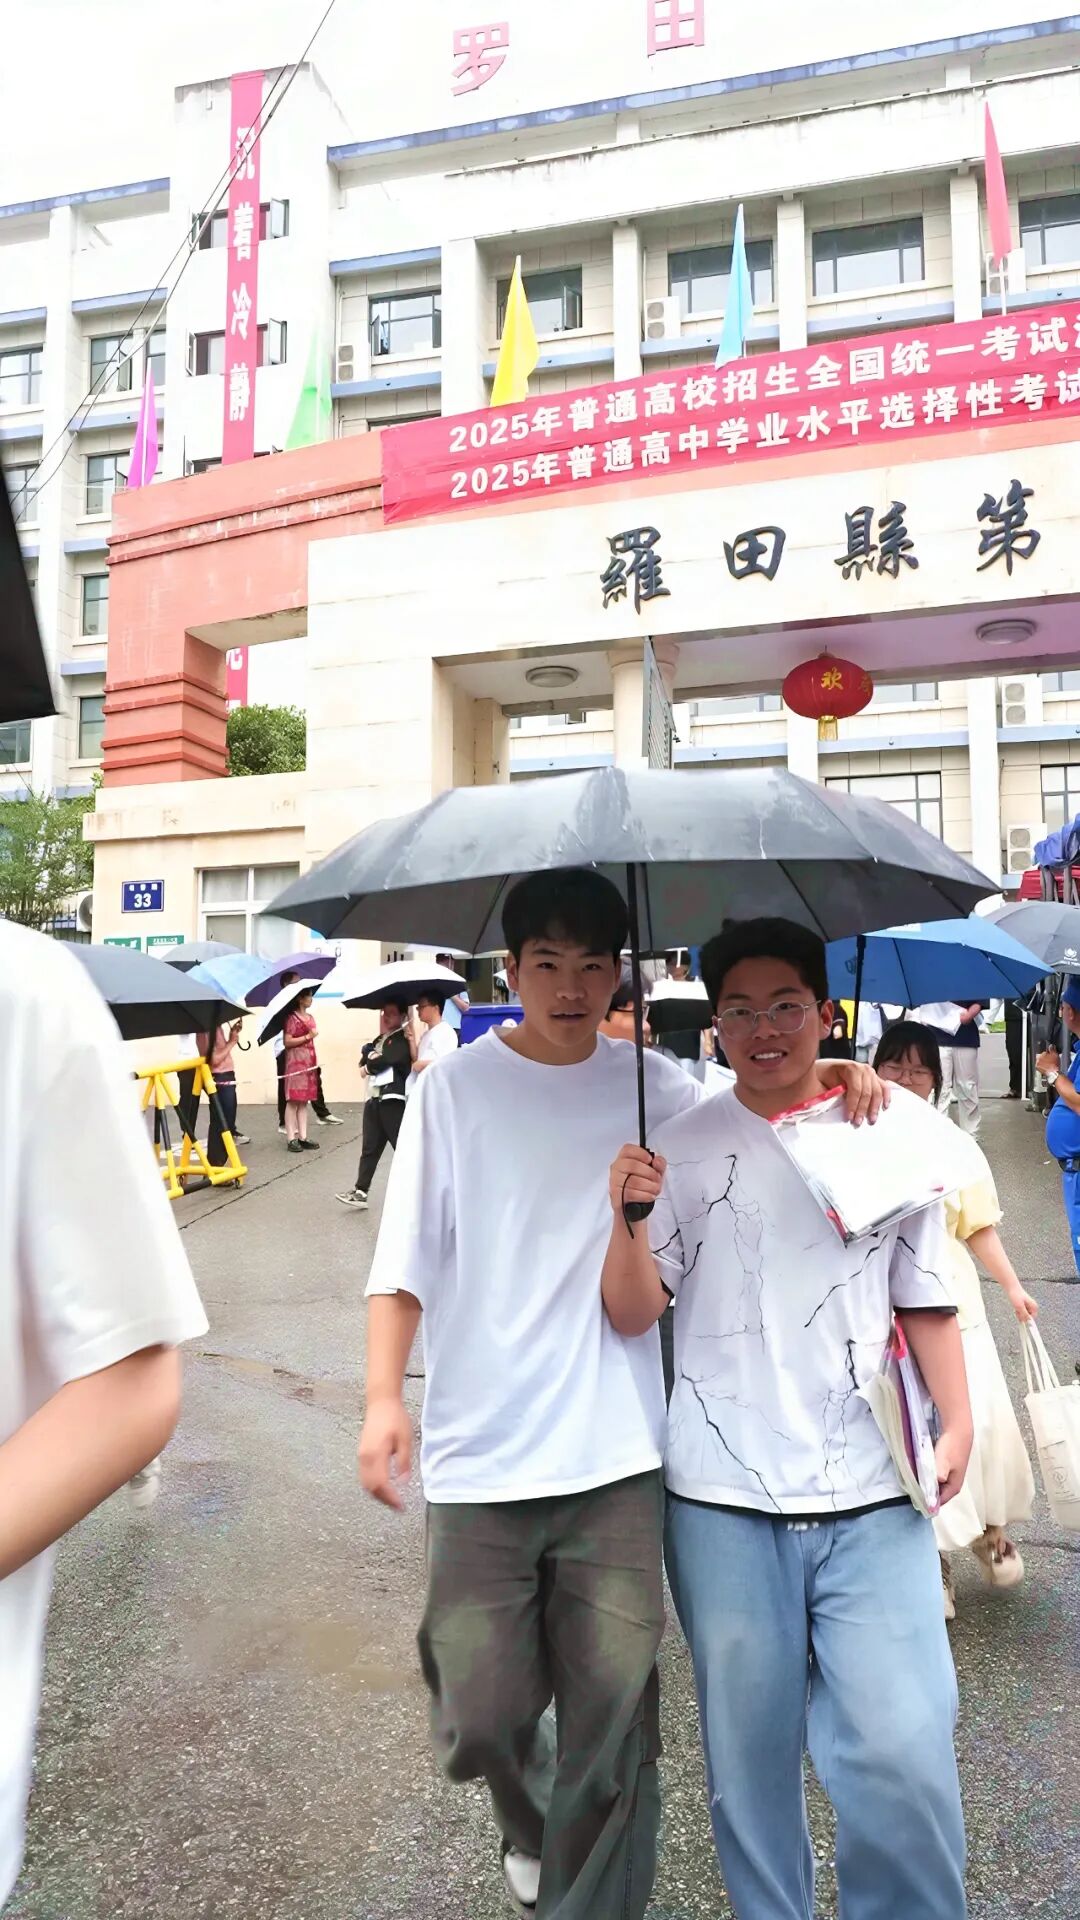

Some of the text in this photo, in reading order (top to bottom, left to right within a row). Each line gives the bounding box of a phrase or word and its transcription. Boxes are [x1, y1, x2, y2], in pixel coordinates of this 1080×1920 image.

[451, 0, 705, 97] 罗田
[449, 314, 1080, 453] 2025年普通高校招生全国统一考试
[600, 479, 1041, 615] 羅田縣第
[820, 666, 844, 691] 欢
[134, 892, 152, 909] 33
